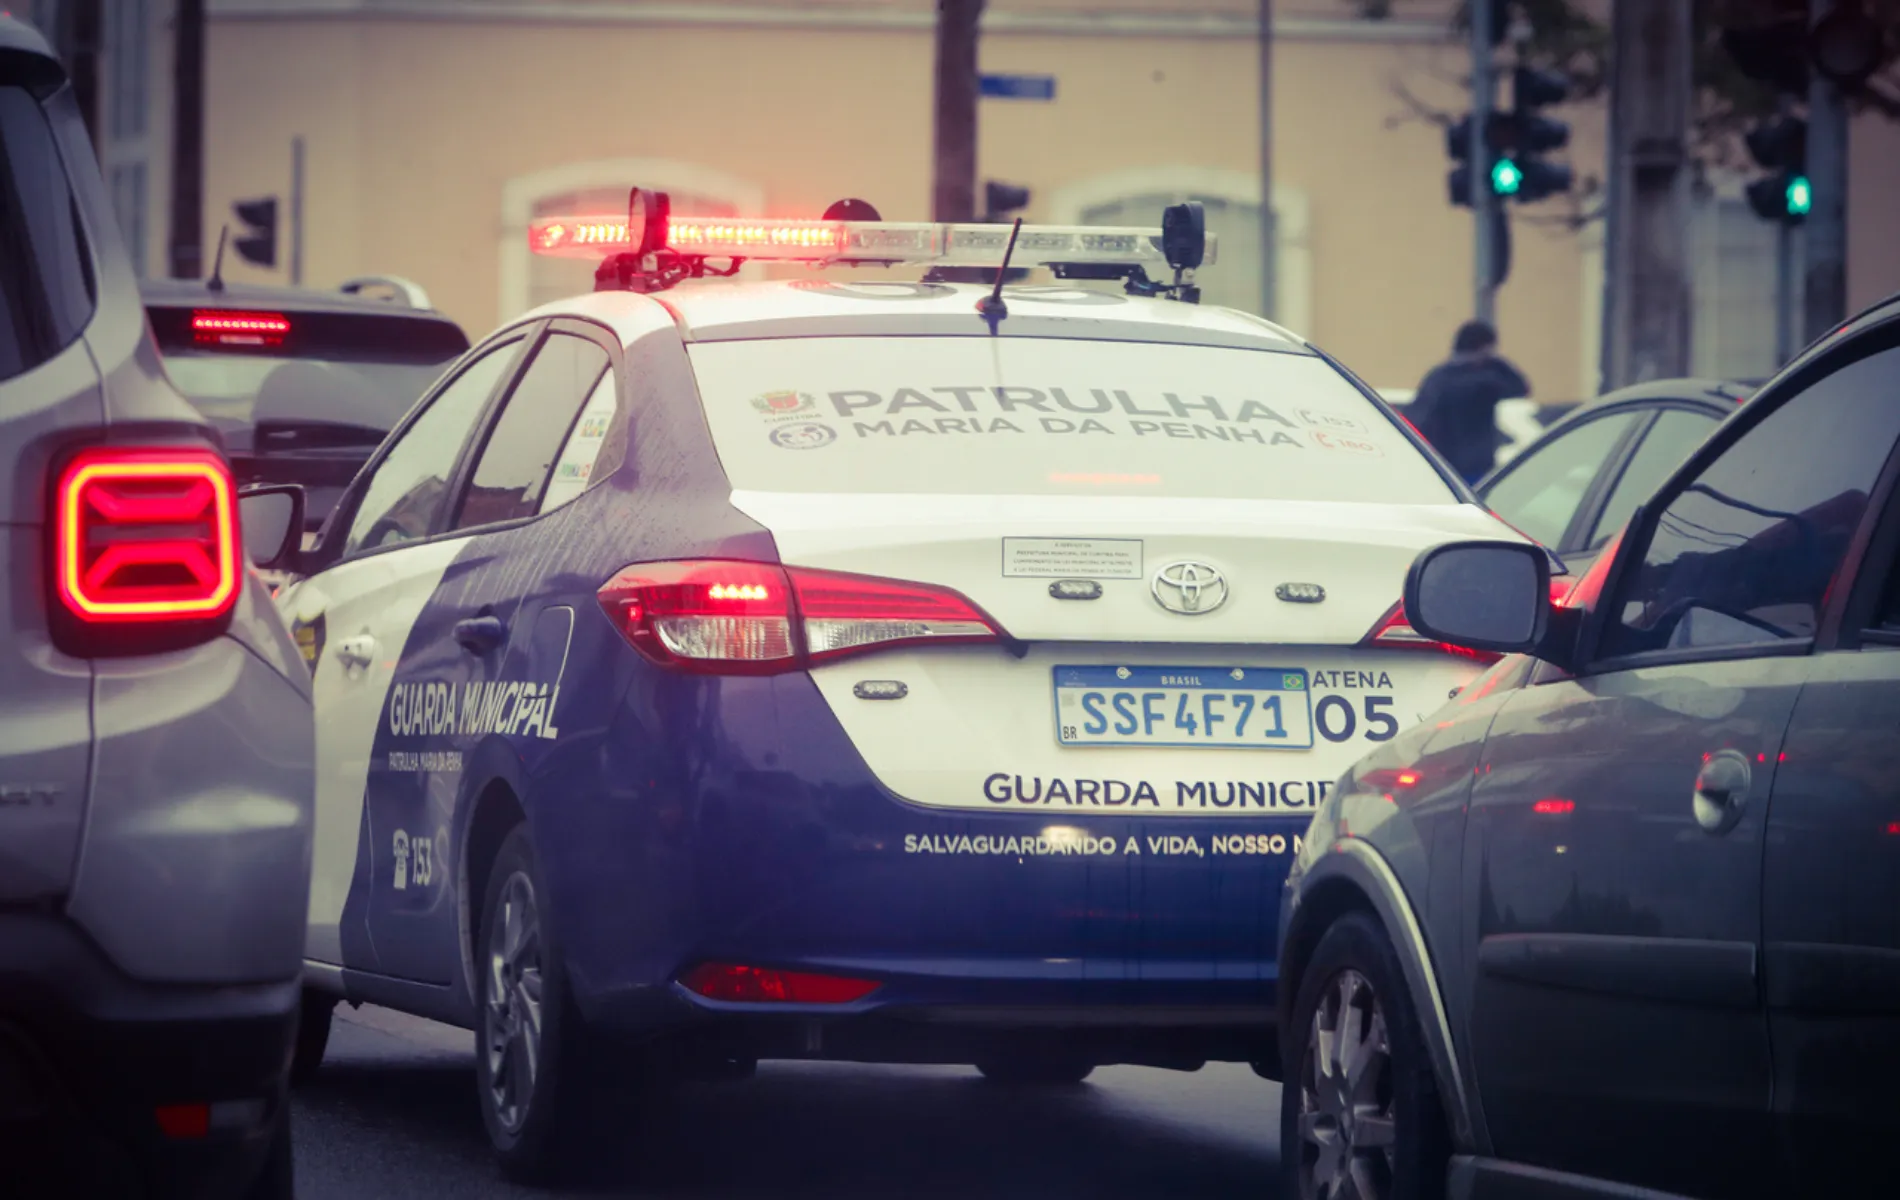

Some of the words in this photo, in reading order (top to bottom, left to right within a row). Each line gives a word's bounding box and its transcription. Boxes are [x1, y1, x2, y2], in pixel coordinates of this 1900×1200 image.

[826, 386, 1300, 428] PATRULHA
[852, 417, 1024, 438] MARIA
[1039, 418, 1115, 435] DA
[1128, 420, 1304, 448] PENHA
[1161, 676, 1201, 686] BRASIL
[1312, 670, 1393, 688] ATENA
[389, 682, 457, 736] GUARDA
[458, 681, 561, 739] MUNICIPAL
[1081, 692, 1287, 738] SSF4F71
[1315, 694, 1399, 743] 05
[1063, 726, 1077, 739] BR
[983, 773, 1160, 807] GUARDA
[412, 836, 432, 886] 153
[904, 834, 1117, 856] SALVAGUARDANDO
[1124, 837, 1140, 855] A
[1148, 836, 1204, 857] VIDA,
[1211, 835, 1286, 855] NOSSO
